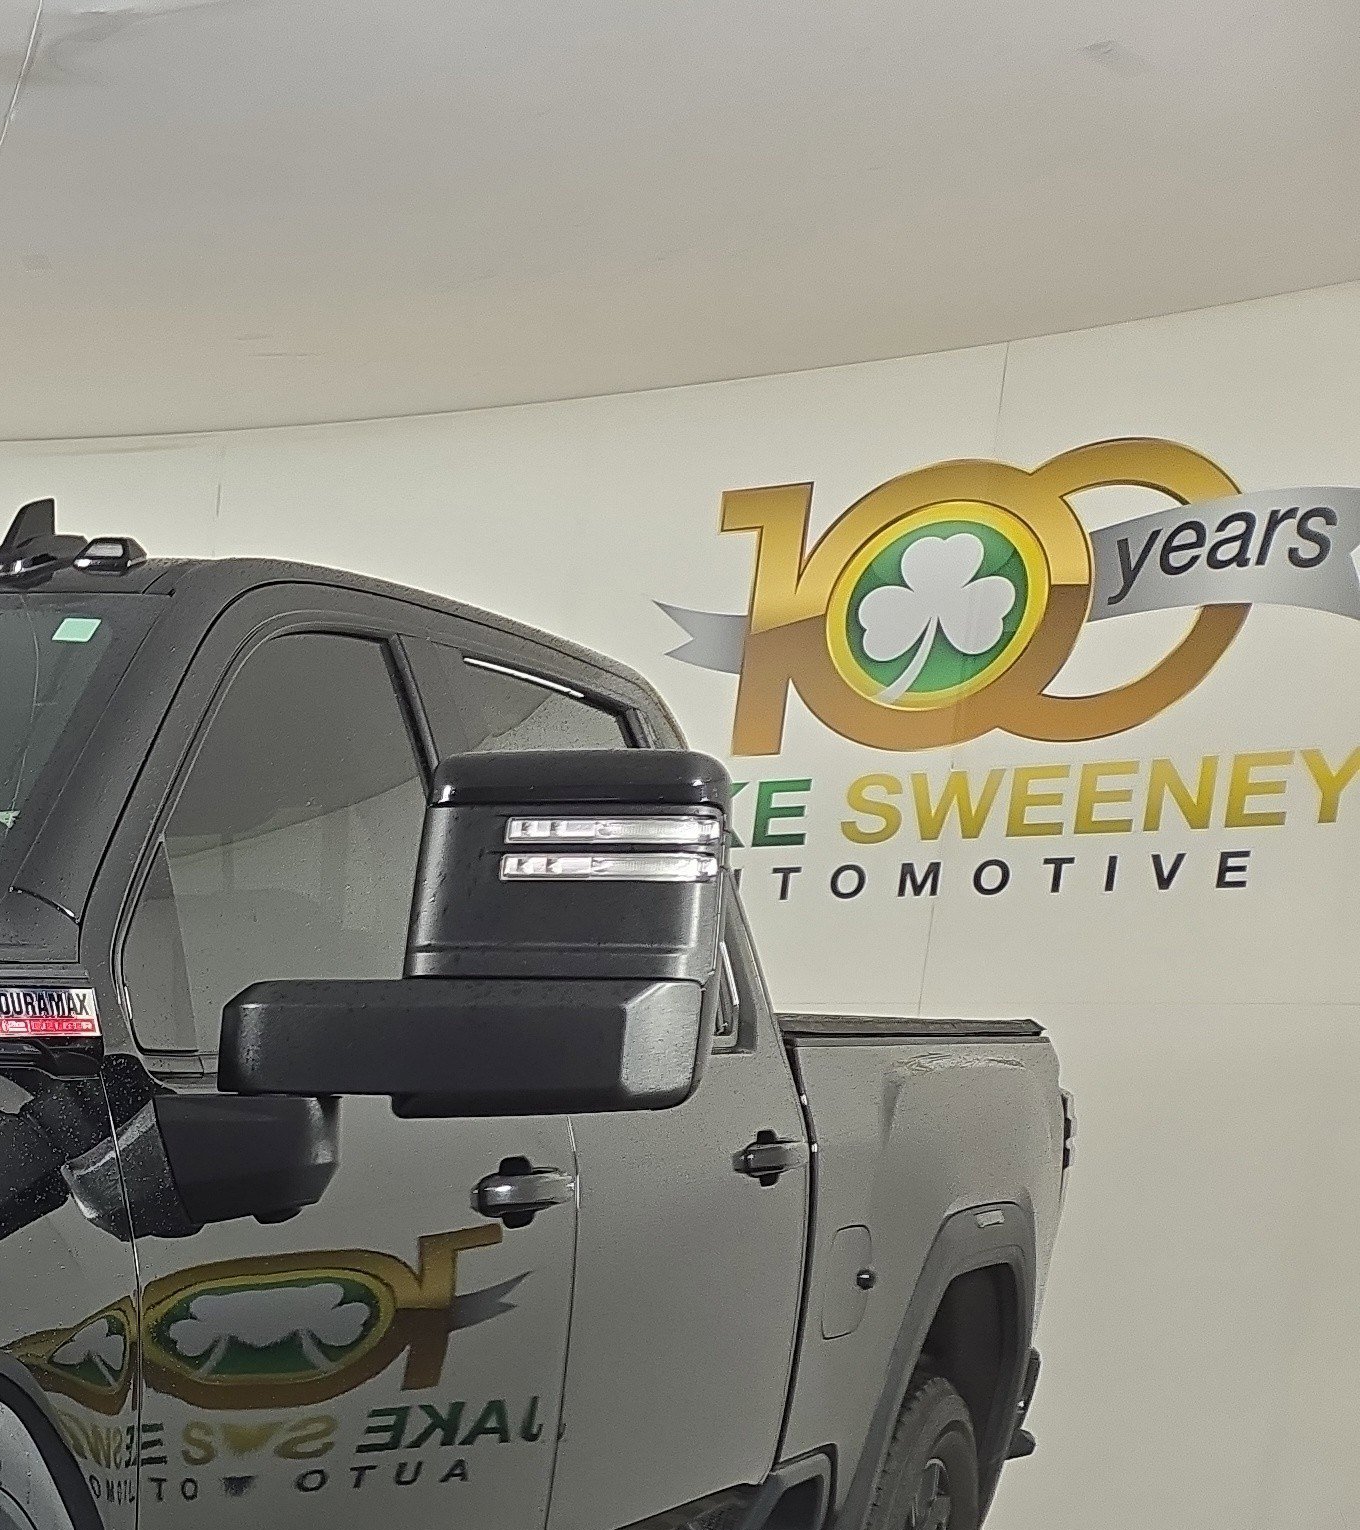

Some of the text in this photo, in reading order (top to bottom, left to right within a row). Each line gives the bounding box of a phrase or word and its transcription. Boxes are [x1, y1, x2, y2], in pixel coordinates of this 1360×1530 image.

[1107, 503, 1338, 606] years
[840, 747, 1360, 845] SWEENEY
[732, 849, 1252, 901] TOMOTIVE
